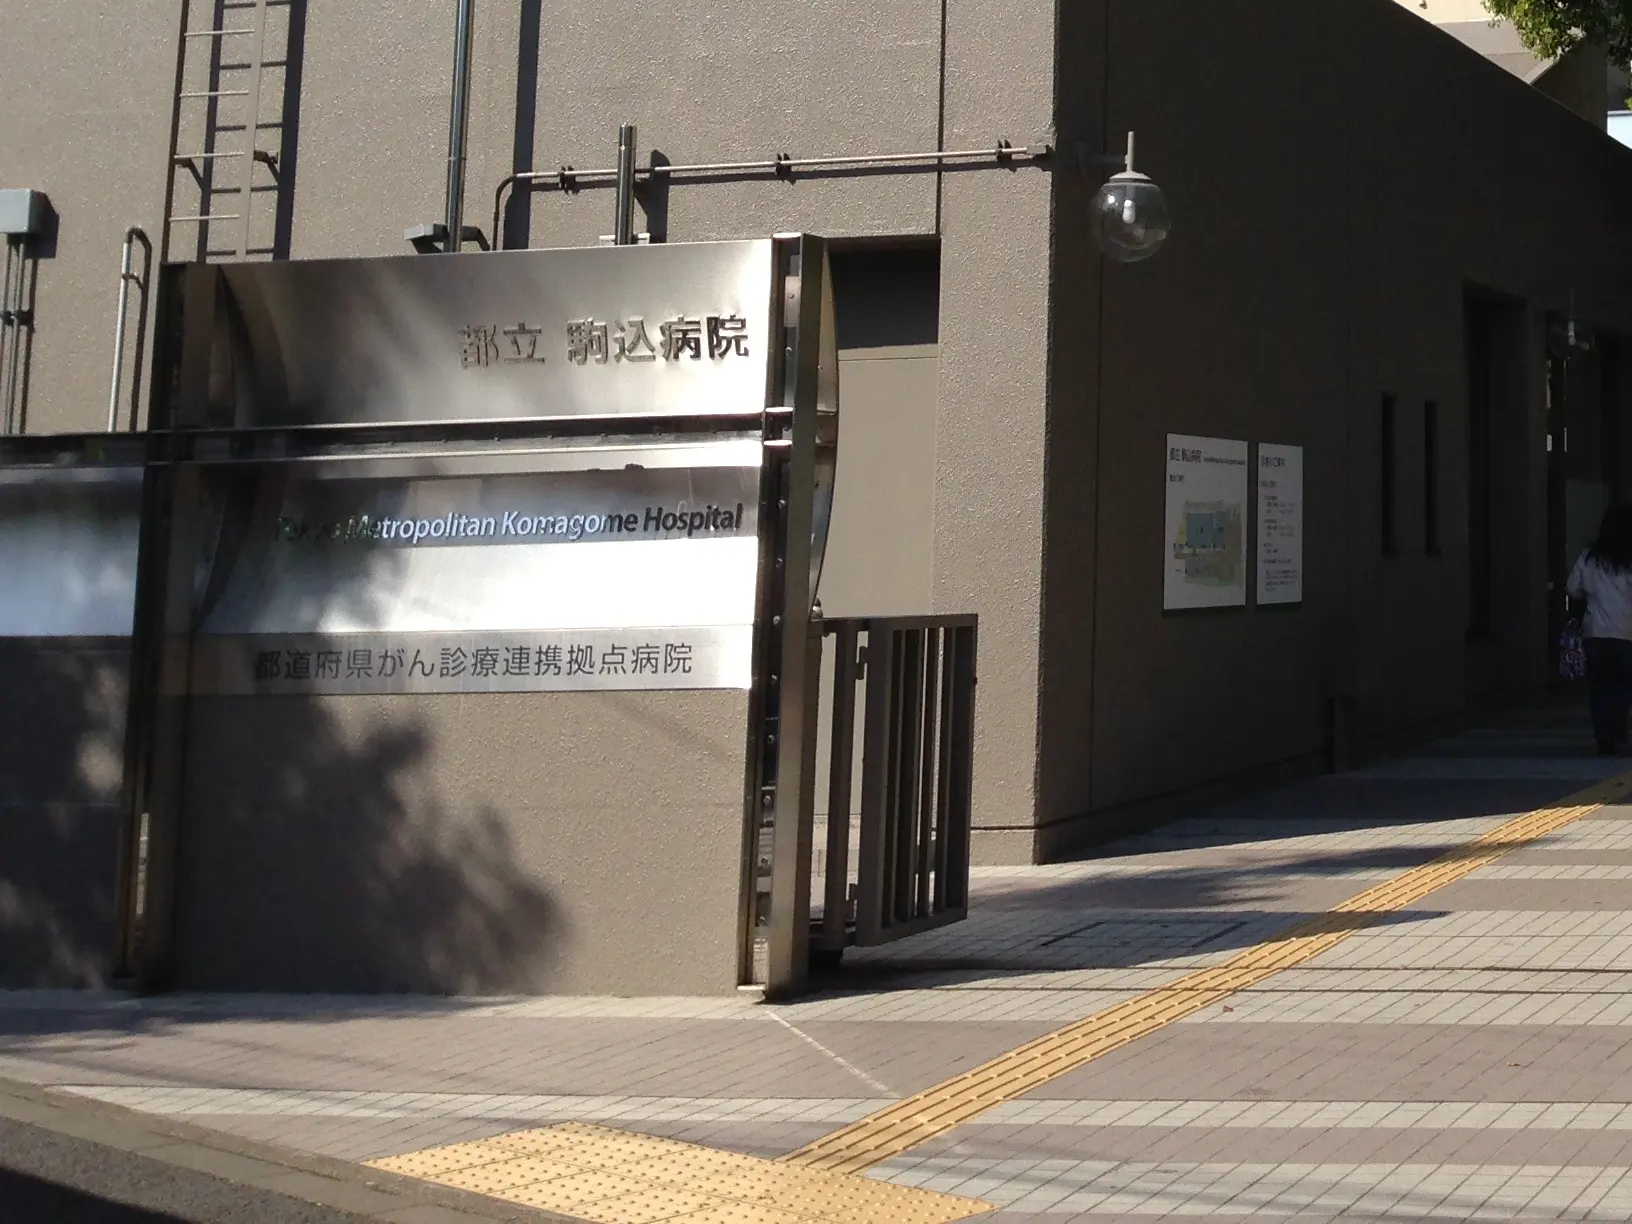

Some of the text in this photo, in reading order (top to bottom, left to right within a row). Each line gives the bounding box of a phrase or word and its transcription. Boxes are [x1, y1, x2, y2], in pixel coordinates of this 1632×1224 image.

[457, 314, 749, 369] 都立 駒込病院
[345, 511, 496, 544] Metropolitan
[500, 509, 638, 541] Komagome
[643, 502, 744, 537] Hospital
[255, 642, 693, 681] 都道府県がん診療連携拠点病院
